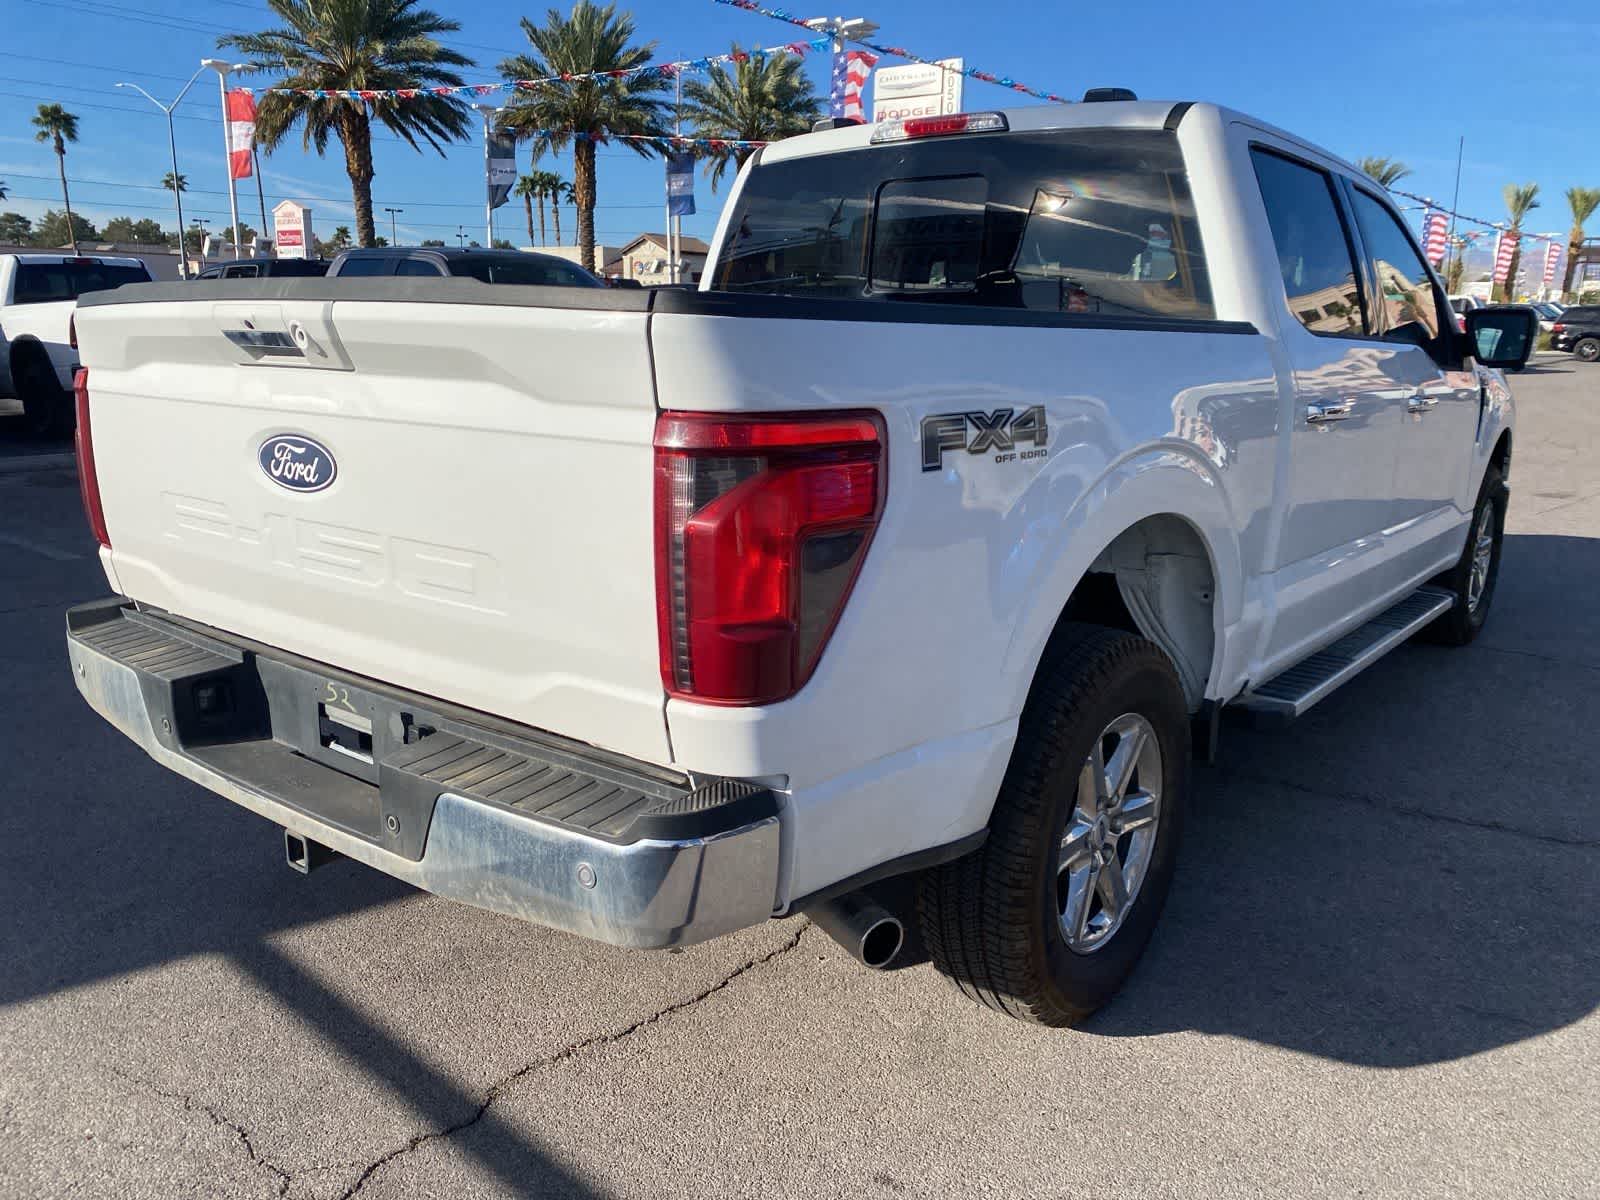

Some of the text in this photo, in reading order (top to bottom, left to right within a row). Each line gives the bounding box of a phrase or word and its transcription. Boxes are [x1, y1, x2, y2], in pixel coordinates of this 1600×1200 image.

[877, 106, 937, 122] DODGE
[920, 405, 1048, 472] FX4
[270, 442, 319, 483] Ford
[995, 449, 1048, 464] OFF ROAD
[325, 681, 357, 713] 52
